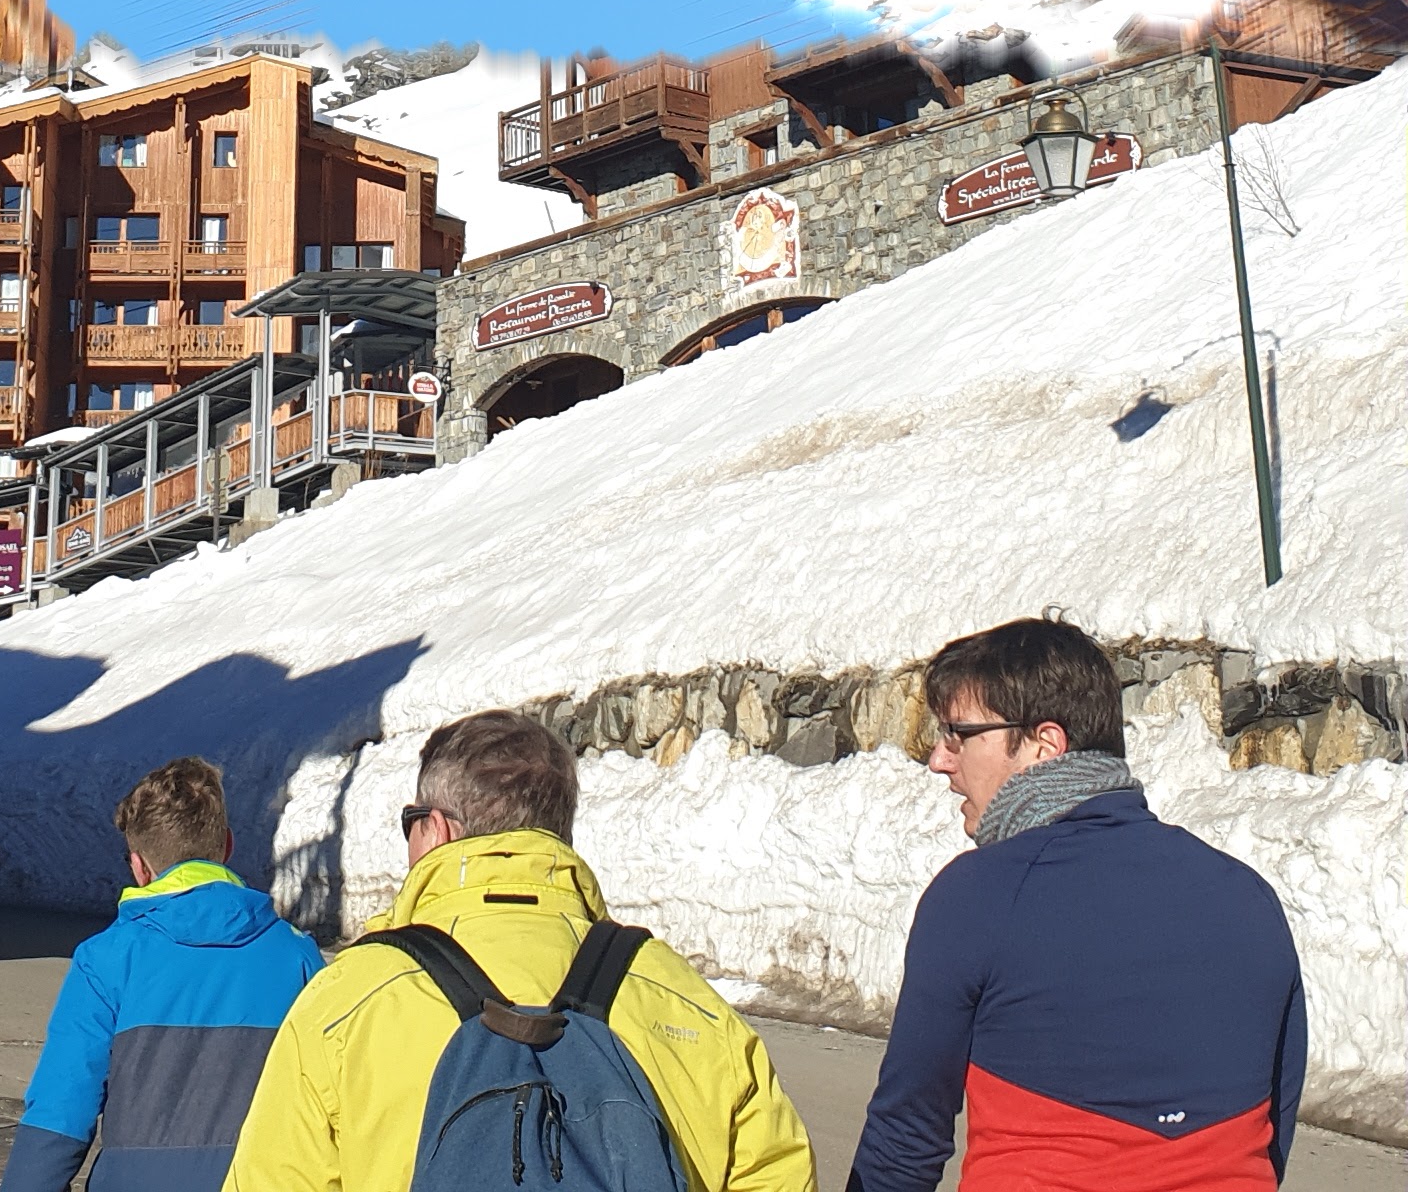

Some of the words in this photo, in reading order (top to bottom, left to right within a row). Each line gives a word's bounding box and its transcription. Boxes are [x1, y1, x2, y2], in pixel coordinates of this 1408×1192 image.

[984, 168, 999, 179] La
[505, 306, 515, 315] La
[516, 302, 537, 316] ferme
[538, 297, 547, 306] de
[489, 310, 548, 334] Restaurant
[548, 299, 592, 320] Pizzeria
